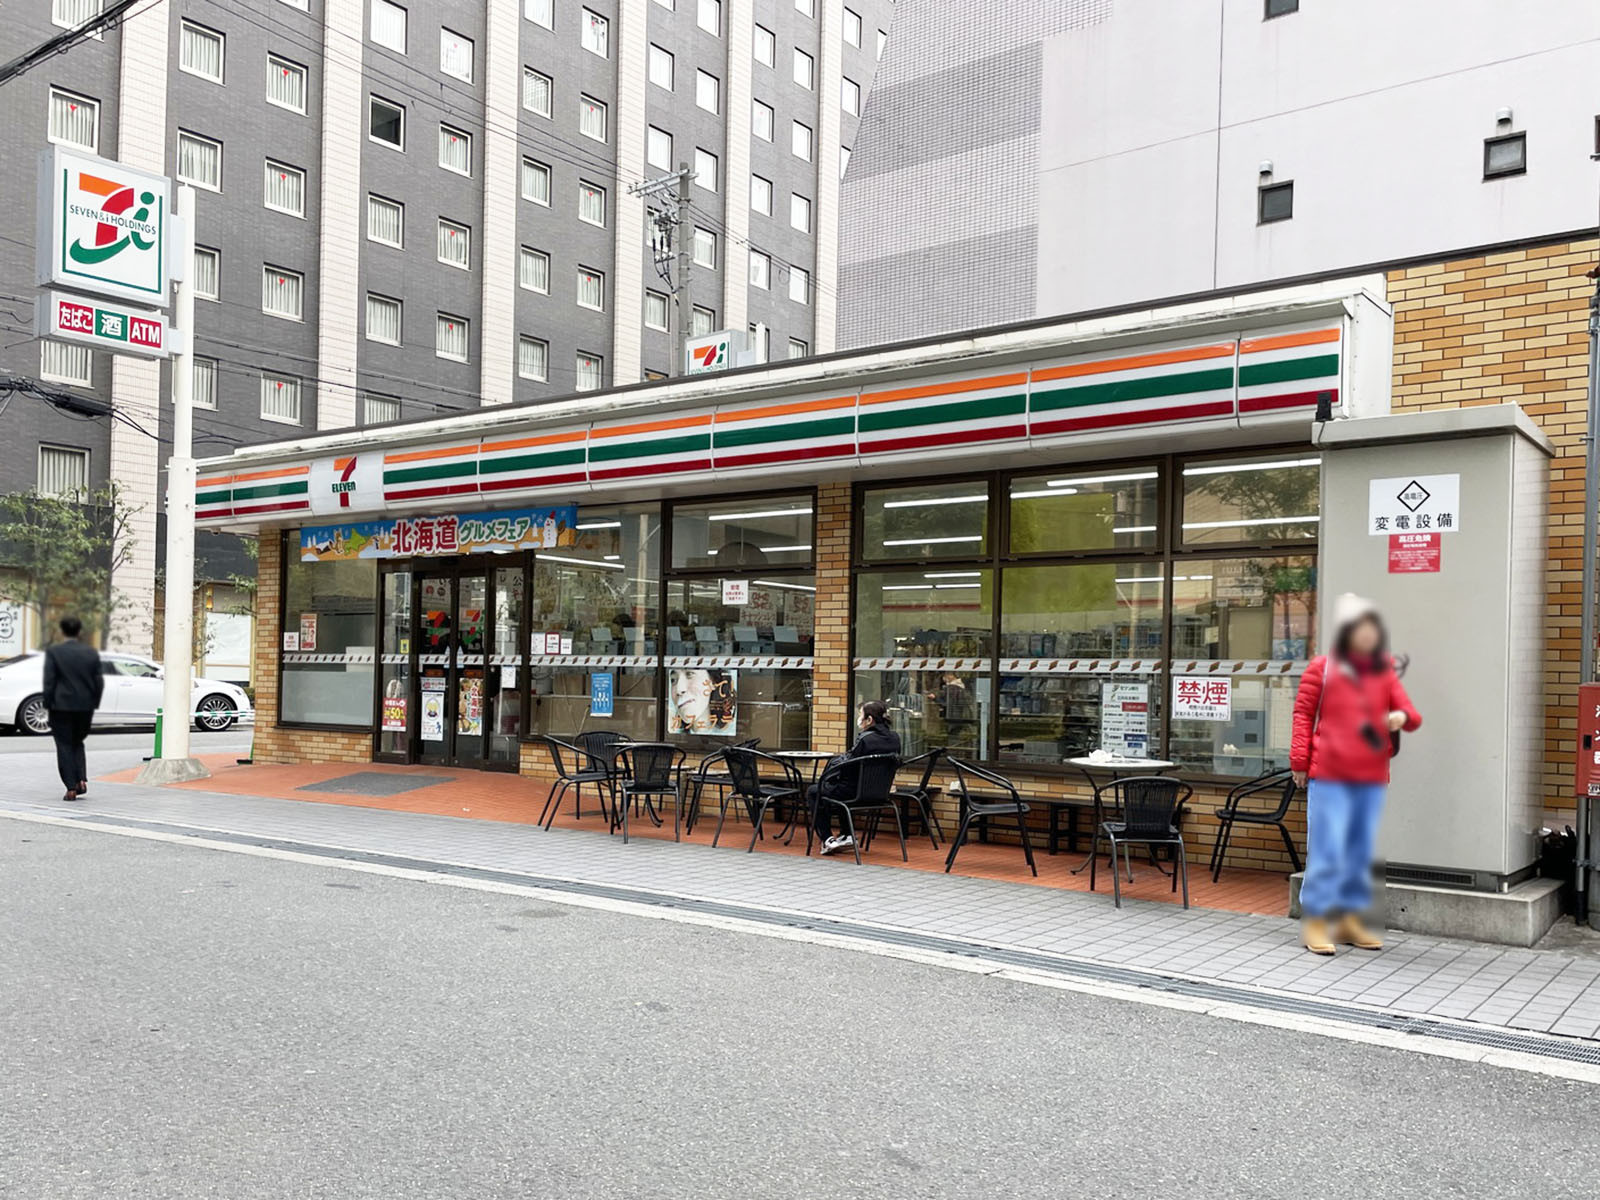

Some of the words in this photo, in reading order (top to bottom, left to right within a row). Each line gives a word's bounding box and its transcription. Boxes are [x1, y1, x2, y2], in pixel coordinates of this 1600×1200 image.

[111, 216, 156, 235] HOLDINGS
[60, 305, 92, 330] たばこ
[101, 313, 122, 336] 酒
[131, 322, 160, 344] ATM
[1376, 513, 1452, 531] 変電設備
[391, 517, 459, 555] 北海道
[459, 518, 530, 544] グルメフェア
[1177, 680, 1228, 705] 禁煙
